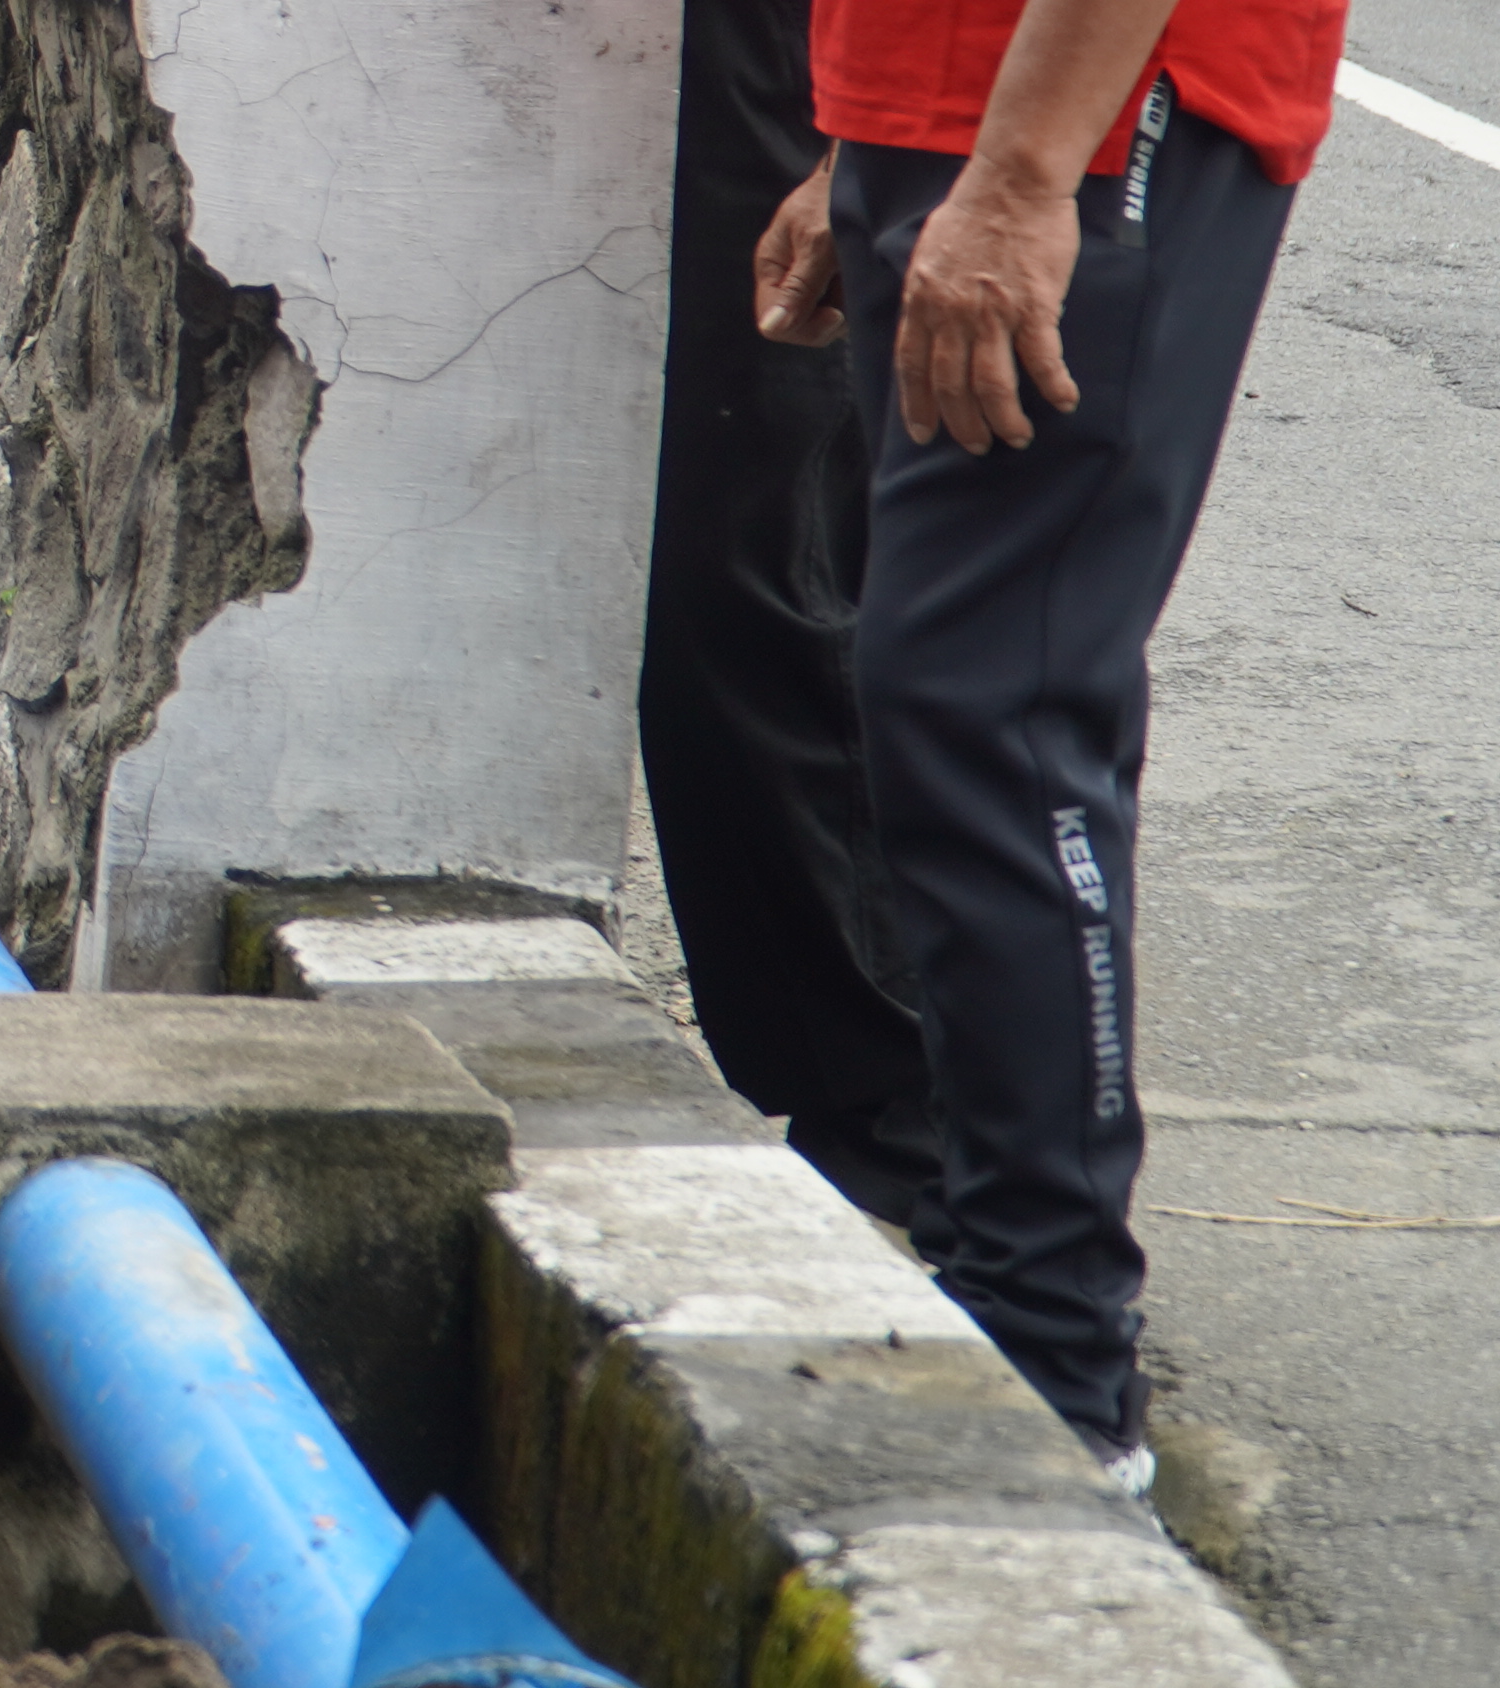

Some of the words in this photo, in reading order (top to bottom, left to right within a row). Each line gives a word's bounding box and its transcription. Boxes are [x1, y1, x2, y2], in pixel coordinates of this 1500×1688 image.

[1123, 138, 1156, 223] SPORTS
[1052, 806, 1109, 914] KEEP
[1081, 923, 1125, 1120] RUNNING
